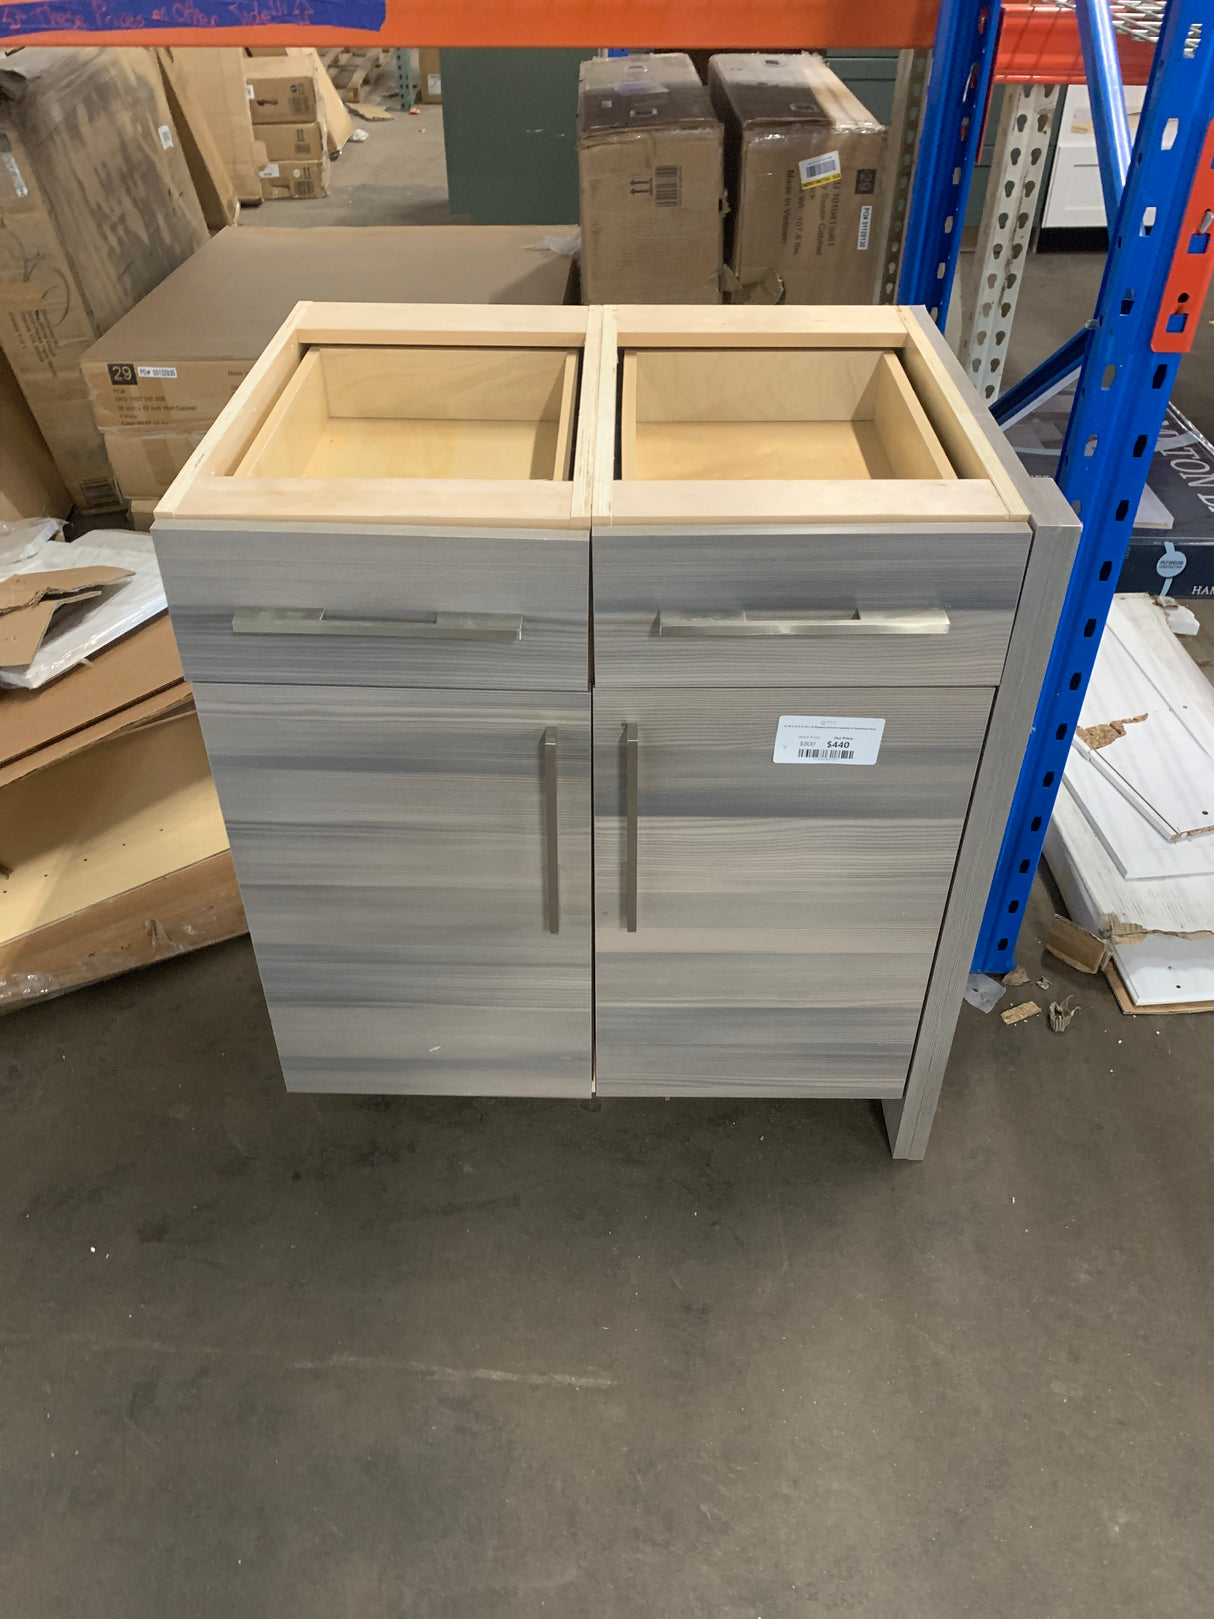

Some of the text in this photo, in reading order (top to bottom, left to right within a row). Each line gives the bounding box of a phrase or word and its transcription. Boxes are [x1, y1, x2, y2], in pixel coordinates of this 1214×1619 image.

[815, 222, 826, 256] Cabinet
[112, 366, 132, 381] 29
[826, 740, 850, 749] $440
